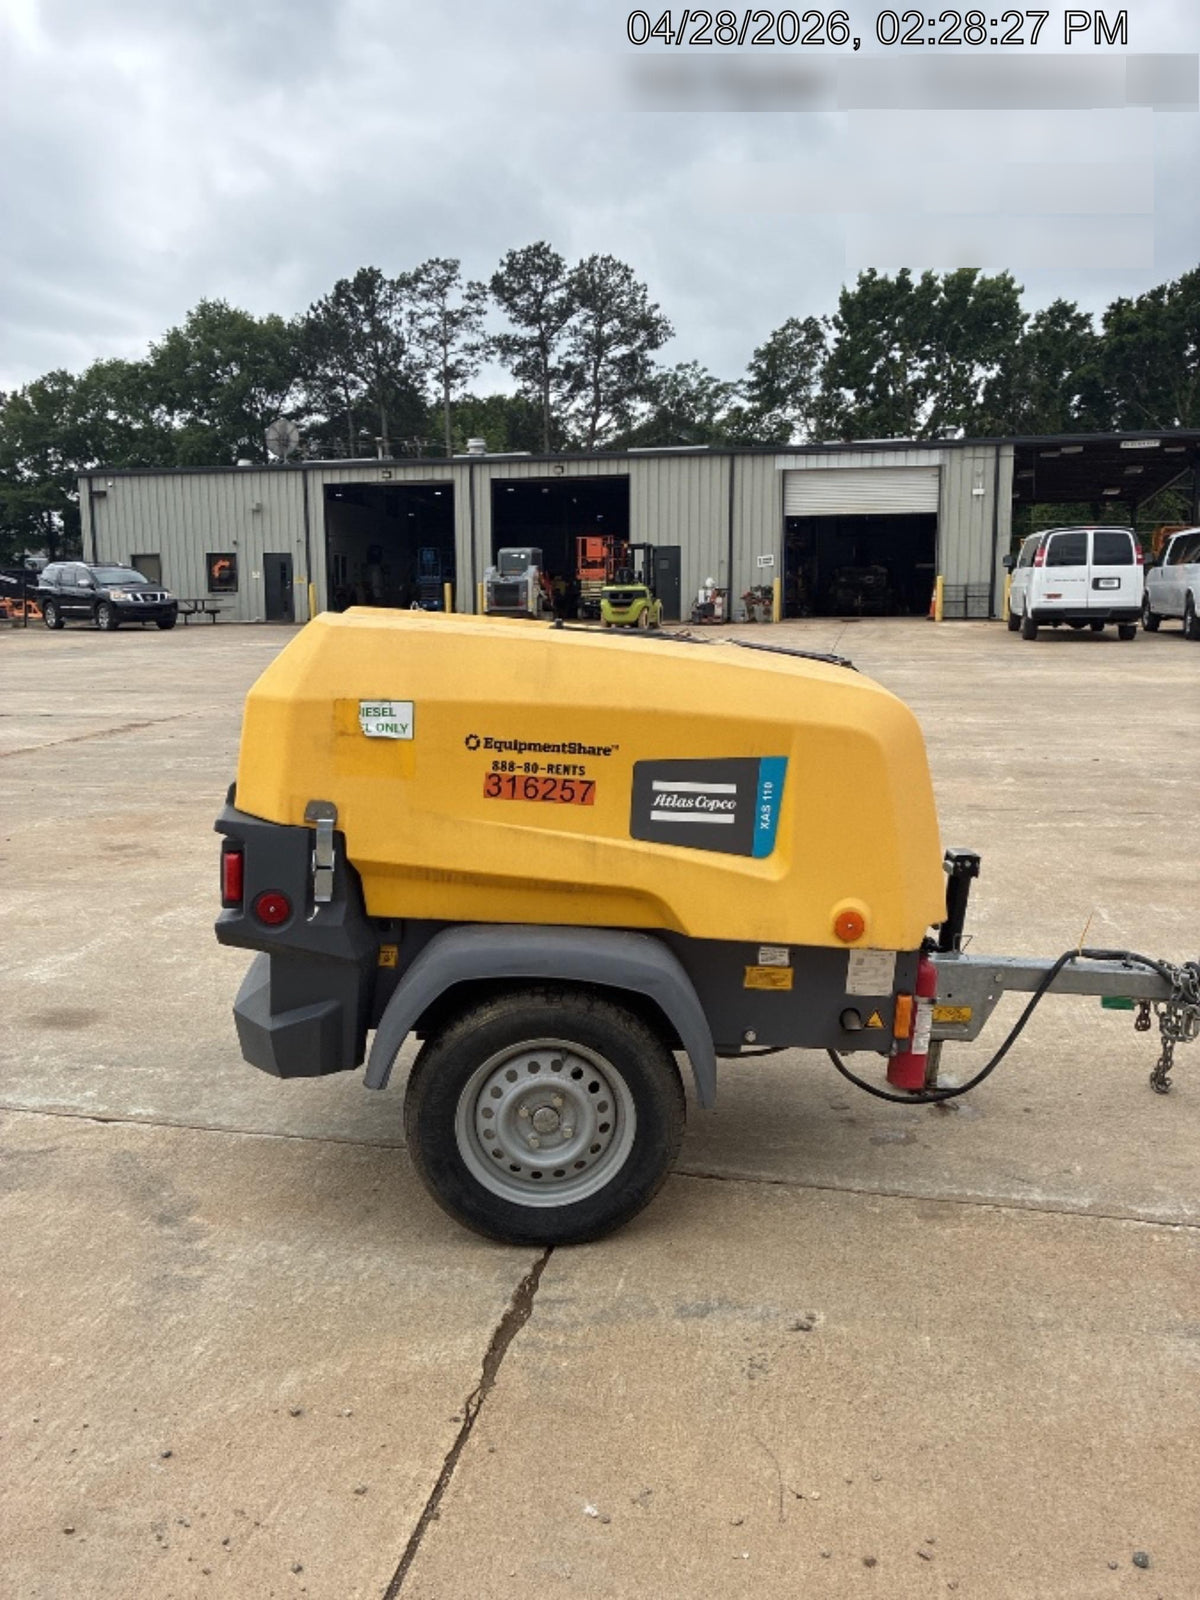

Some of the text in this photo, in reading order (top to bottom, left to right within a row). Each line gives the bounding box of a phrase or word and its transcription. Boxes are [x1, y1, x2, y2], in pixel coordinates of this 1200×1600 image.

[361, 707, 396, 717] IESEL
[376, 723, 409, 735] ONLY
[492, 760, 586, 776] 888-80-RENTS
[486, 773, 595, 803] 316257
[652, 794, 737, 811] Atlas Copco
[760, 781, 774, 830] XAS 110
